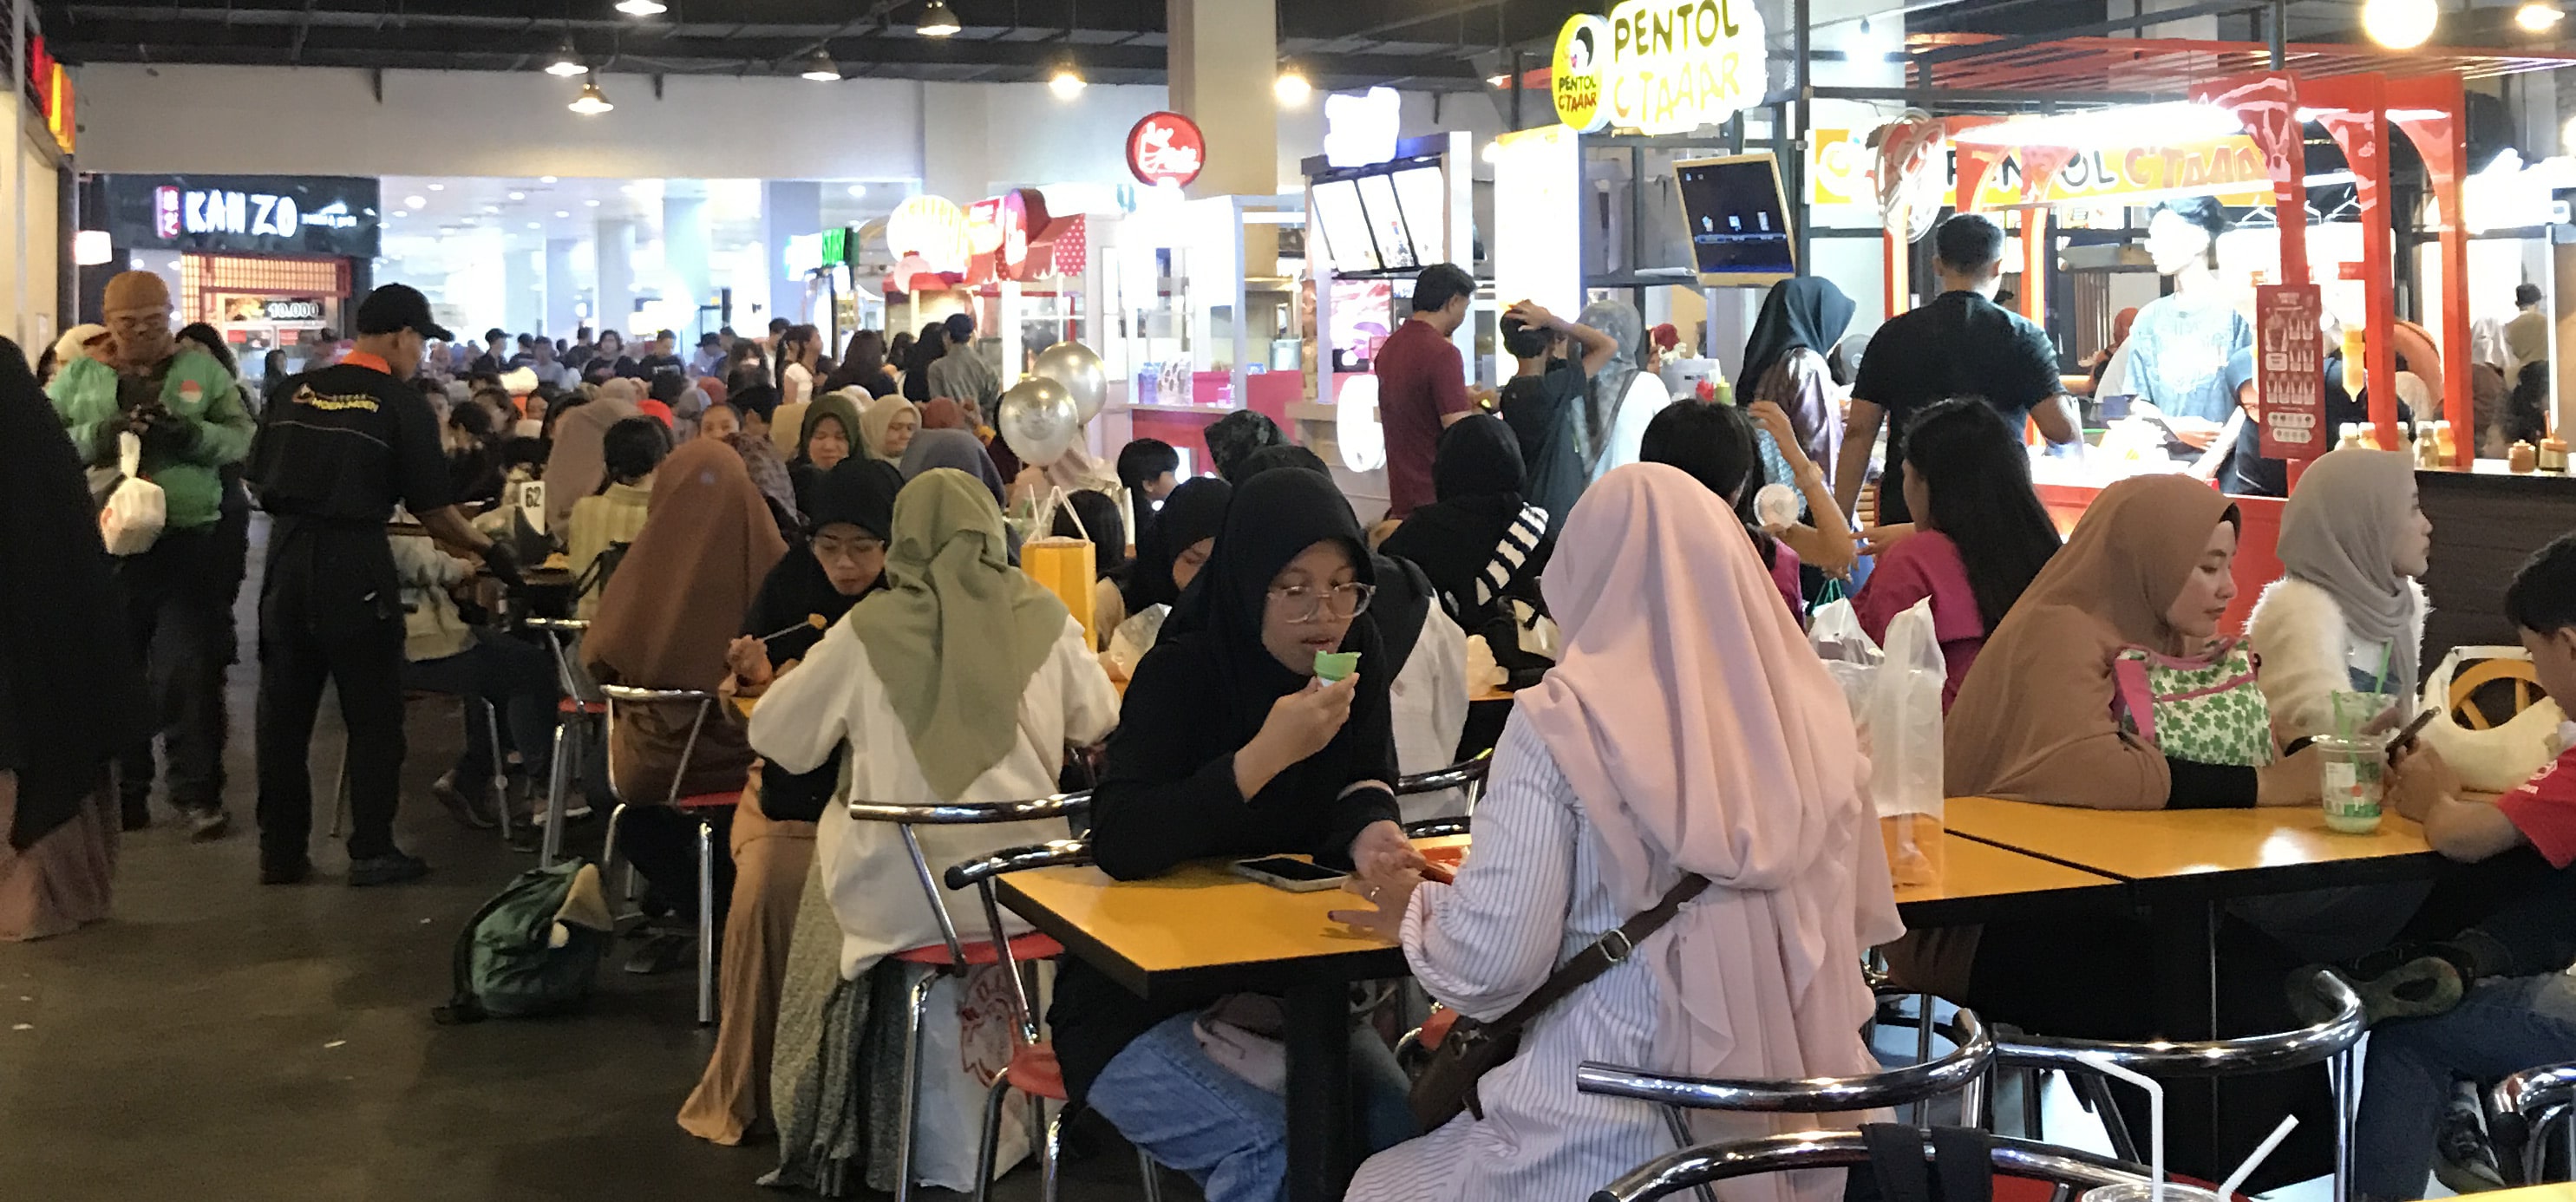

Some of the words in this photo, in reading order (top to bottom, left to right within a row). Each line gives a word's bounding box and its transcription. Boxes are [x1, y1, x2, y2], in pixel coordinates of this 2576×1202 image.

[1614, 0, 1739, 63] PENTOL
[1559, 75, 1597, 93] PENTOL
[526, 486, 542, 508] 62
